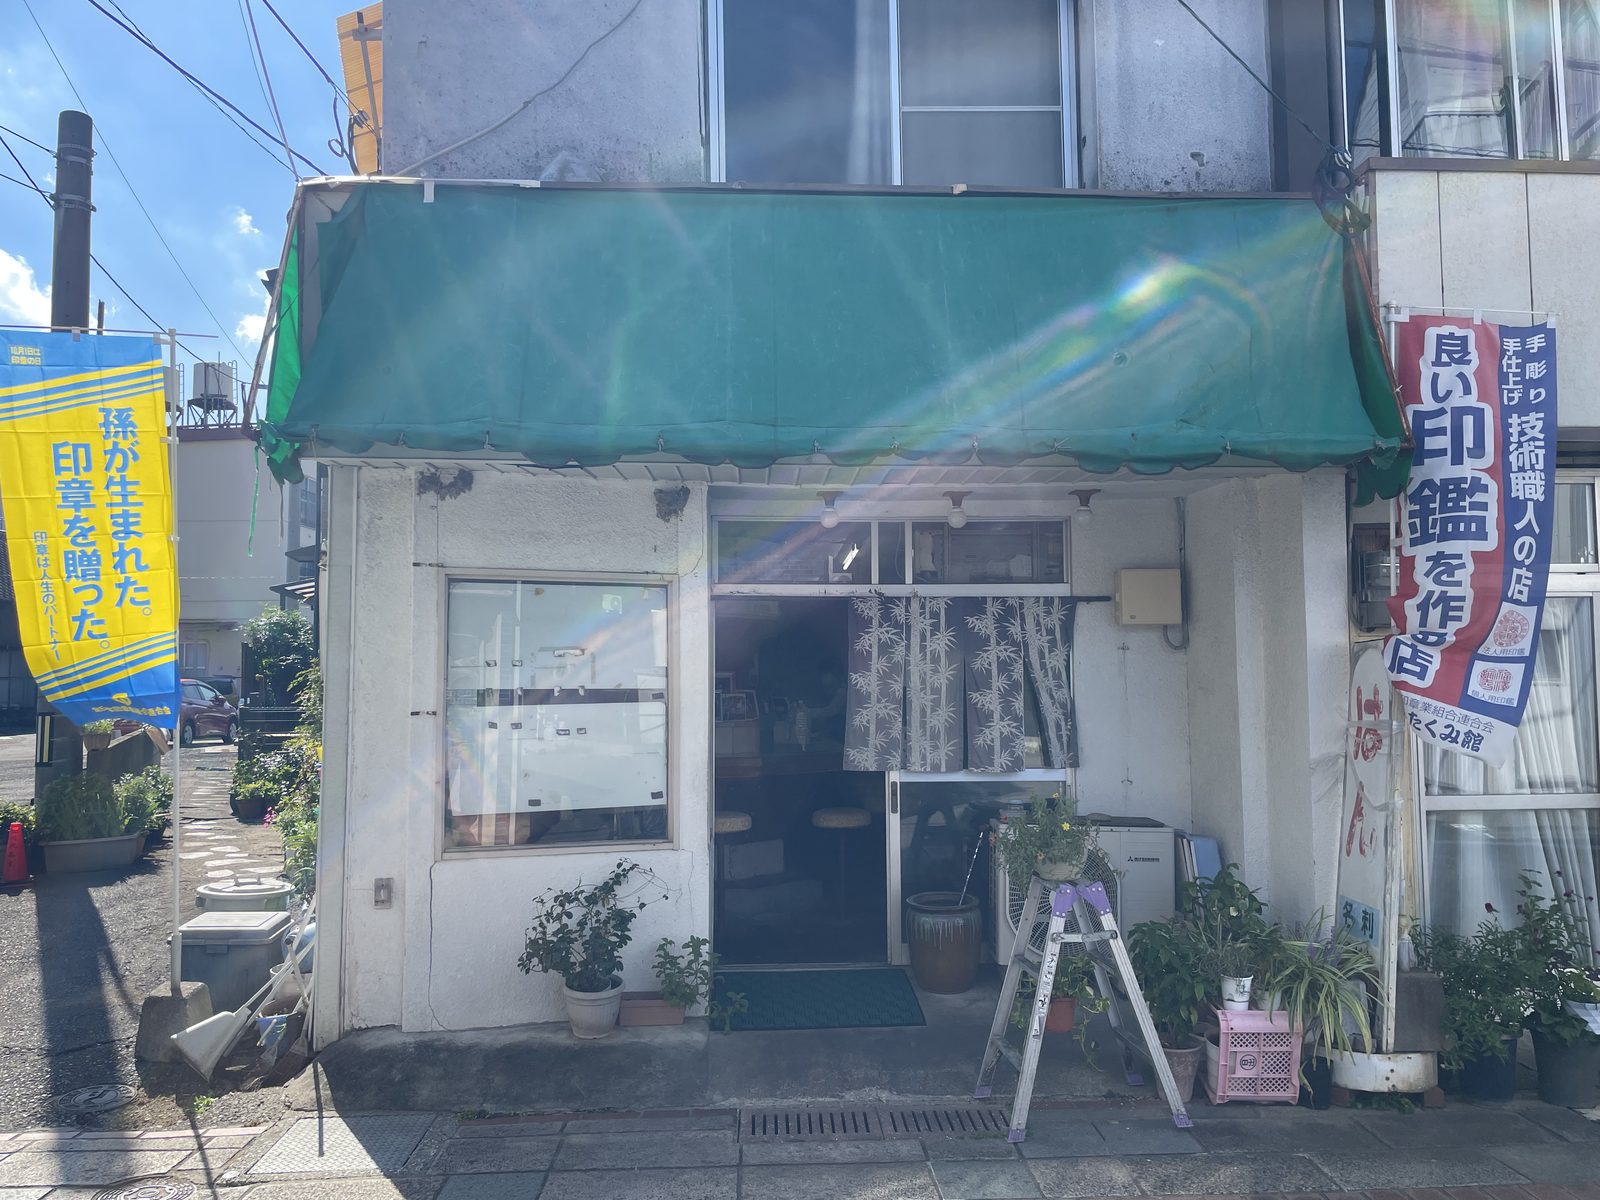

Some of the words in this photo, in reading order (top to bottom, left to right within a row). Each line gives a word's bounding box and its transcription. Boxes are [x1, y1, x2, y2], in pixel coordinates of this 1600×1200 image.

[1501, 337, 1523, 406] 手仕上げ
[1524, 333, 1548, 405] 手彫り
[51, 441, 111, 650] 印章を贈った。
[97, 407, 153, 617] 孫が生まれた。
[1507, 411, 1546, 603] 技術職人の店
[33, 531, 61, 661] 印章は人生のパートナー
[1408, 711, 1485, 752] たくみ館
